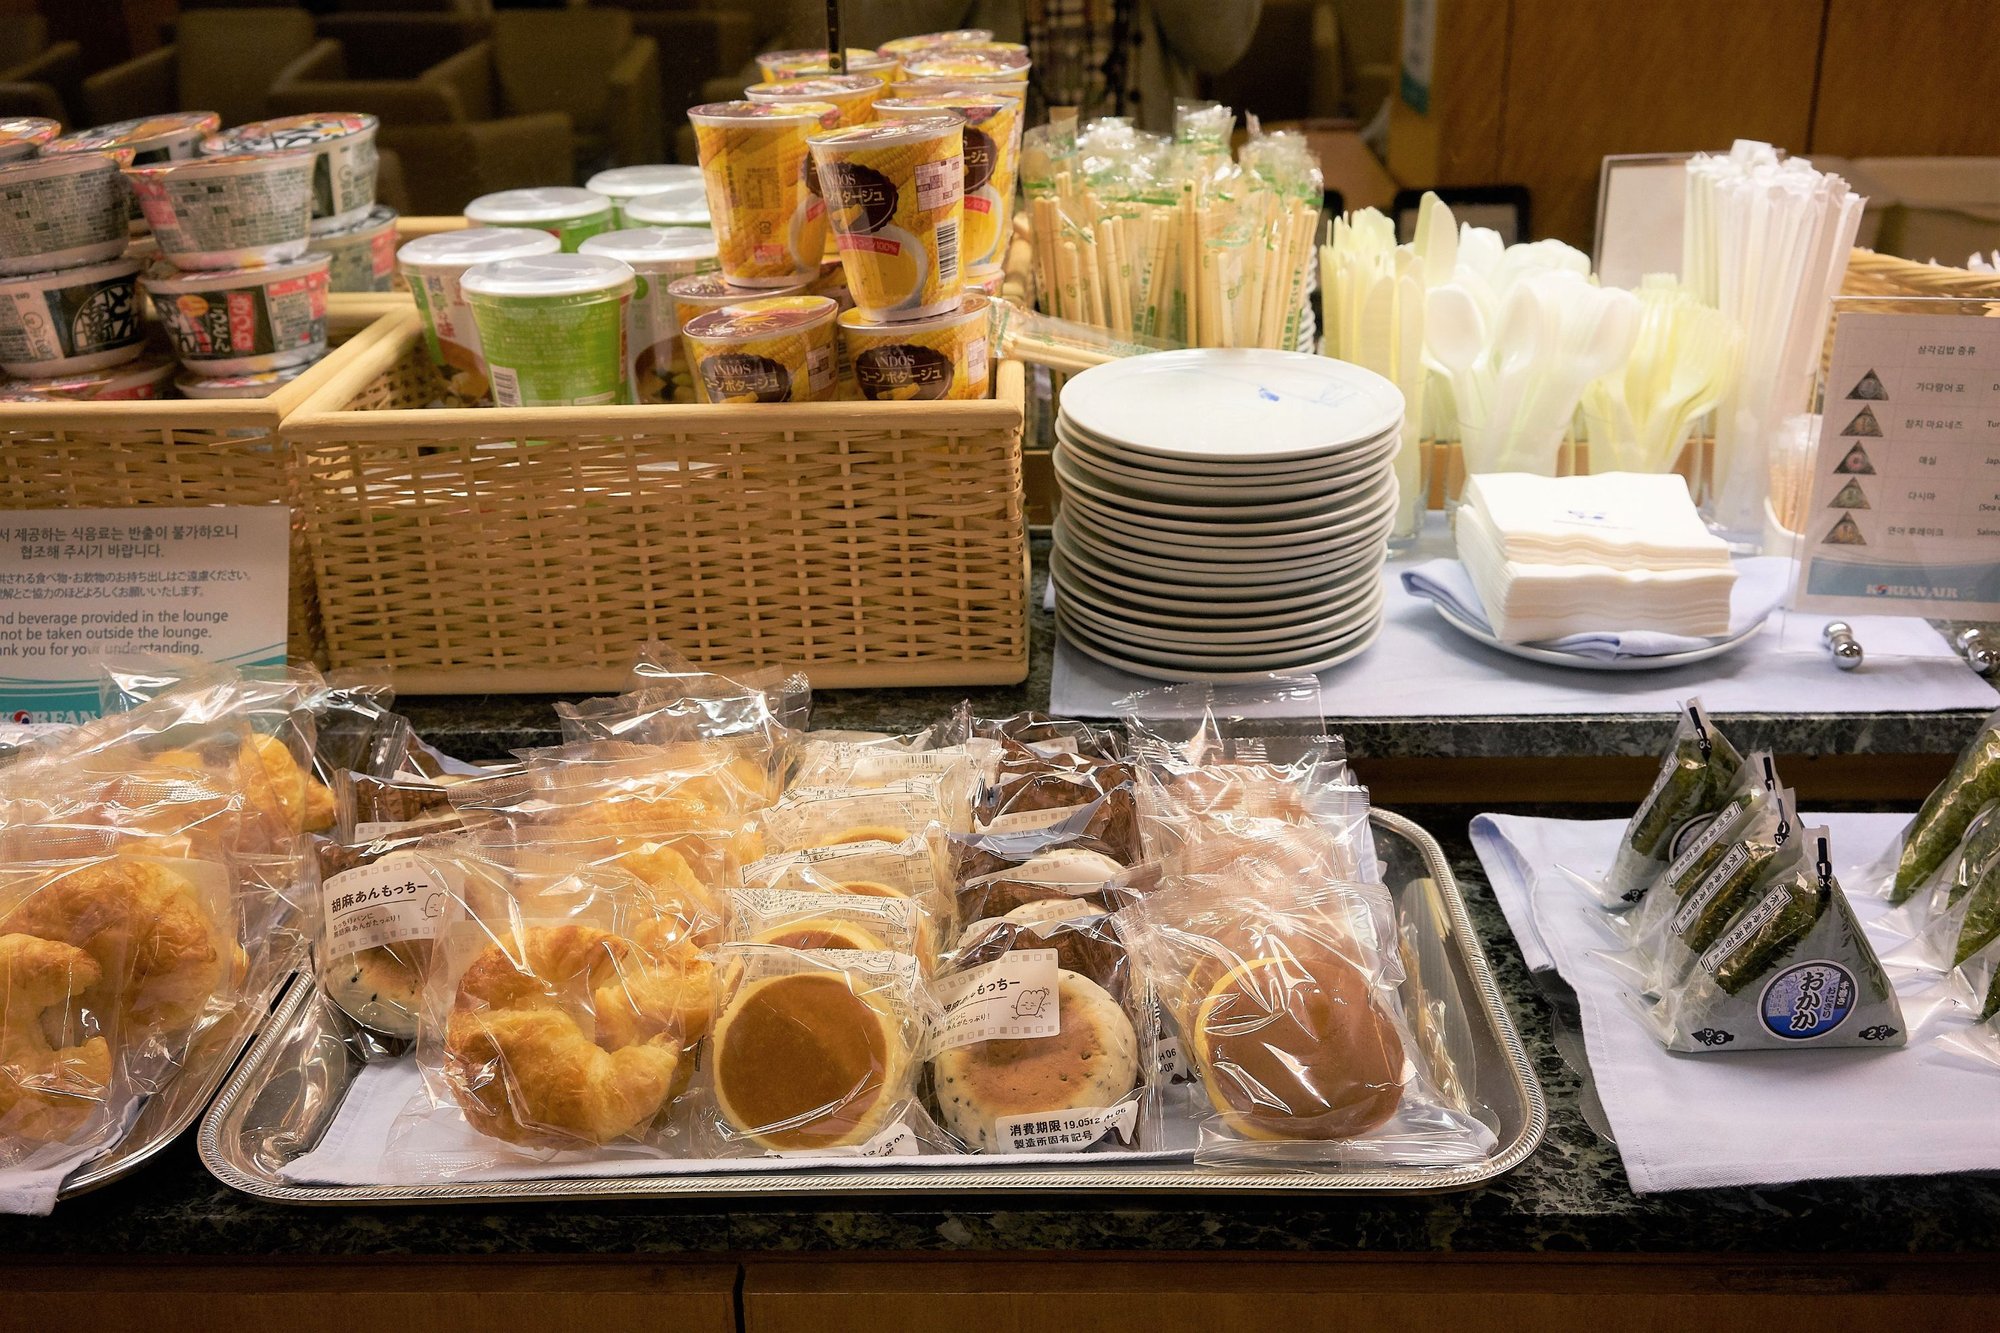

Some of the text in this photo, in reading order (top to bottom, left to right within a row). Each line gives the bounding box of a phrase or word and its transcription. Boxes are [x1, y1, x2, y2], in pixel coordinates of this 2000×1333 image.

[14, 527, 66, 542] 제공하는
[72, 526, 124, 541] 식음료는
[128, 525, 168, 540] 반출이
[172, 524, 239, 540] 불가하오니
[21, 543, 165, 560] 협조해 주시기 바랍니다.
[19, 611, 78, 625] beverage
[81, 610, 139, 625] provided
[142, 610, 154, 623] in
[158, 610, 180, 622] the
[183, 609, 229, 624] lounge
[26, 627, 42, 640] be
[46, 627, 82, 639] taken
[86, 626, 134, 640] outside
[138, 626, 159, 639] the
[162, 625, 213, 639] lounge.
[22, 646, 46, 658] you
[50, 642, 70, 655] for
[331, 881, 428, 914] 胡麻あんもっちー
[1790, 971, 1825, 1030] おかか
[1715, 1033, 1725, 1044] 3
[1866, 1028, 1876, 1039] 2
[1010, 1119, 1062, 1137] 消費期限
[1014, 1130, 1094, 1149] 製造所固有記号
